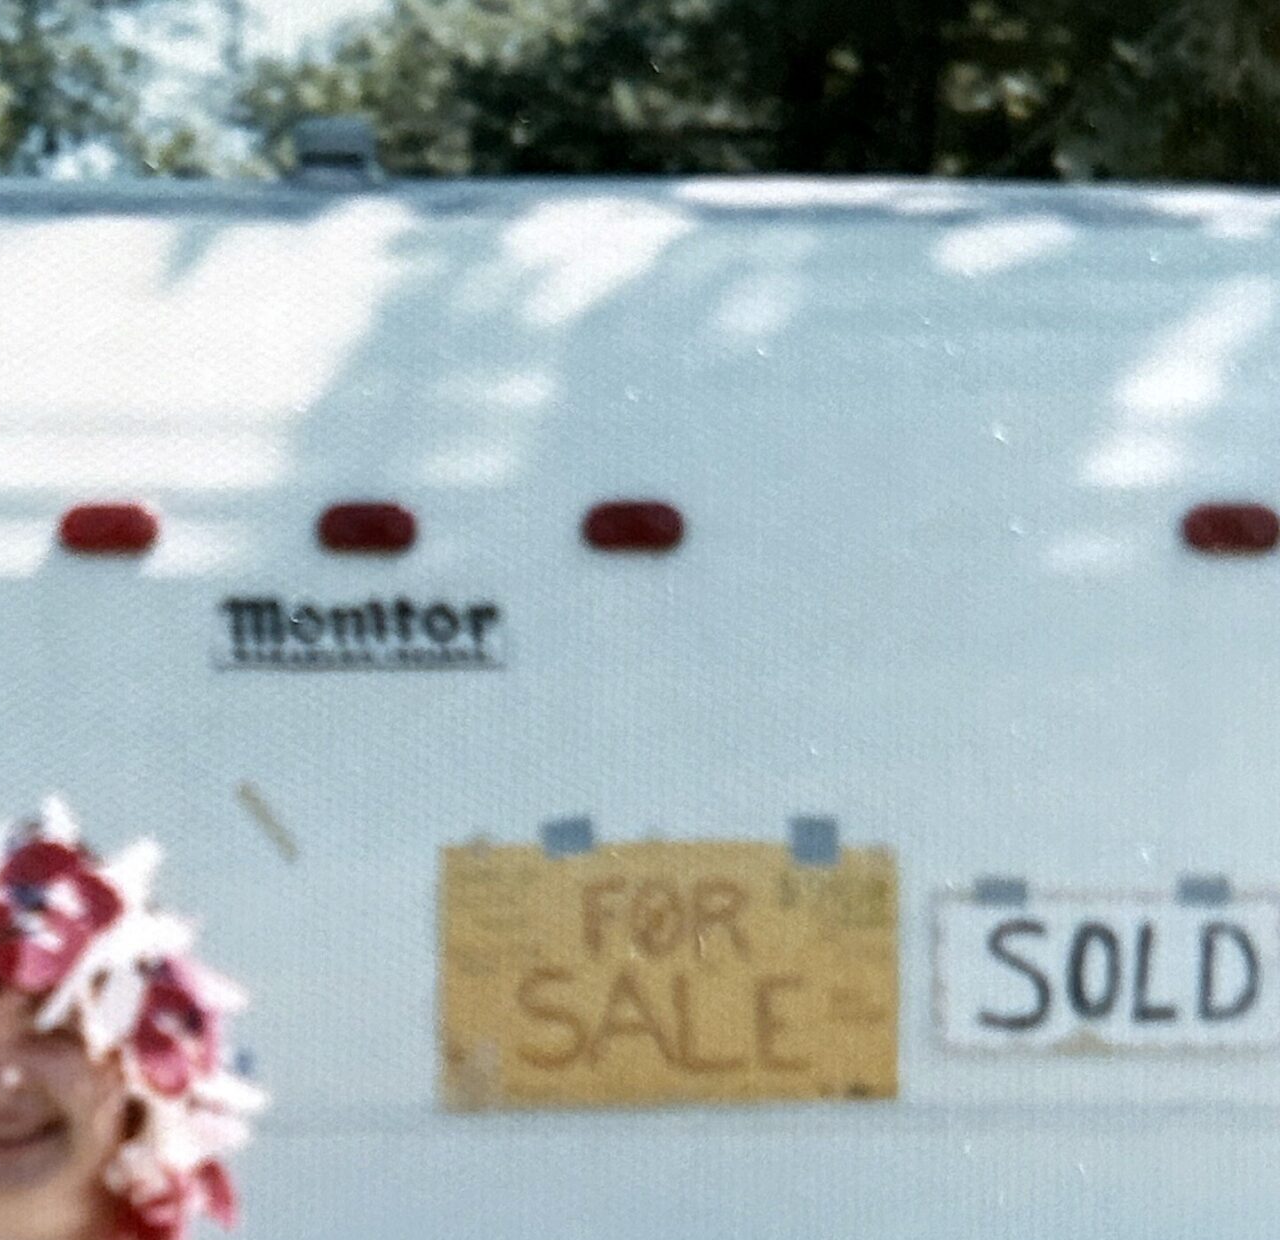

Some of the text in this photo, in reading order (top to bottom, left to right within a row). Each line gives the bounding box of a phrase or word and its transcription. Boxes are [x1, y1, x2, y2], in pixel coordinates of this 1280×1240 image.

[220, 596, 499, 648] Monitor
[582, 876, 751, 960] FOR
[518, 965, 814, 1075] SALE
[977, 919, 1260, 1031] SOLD
